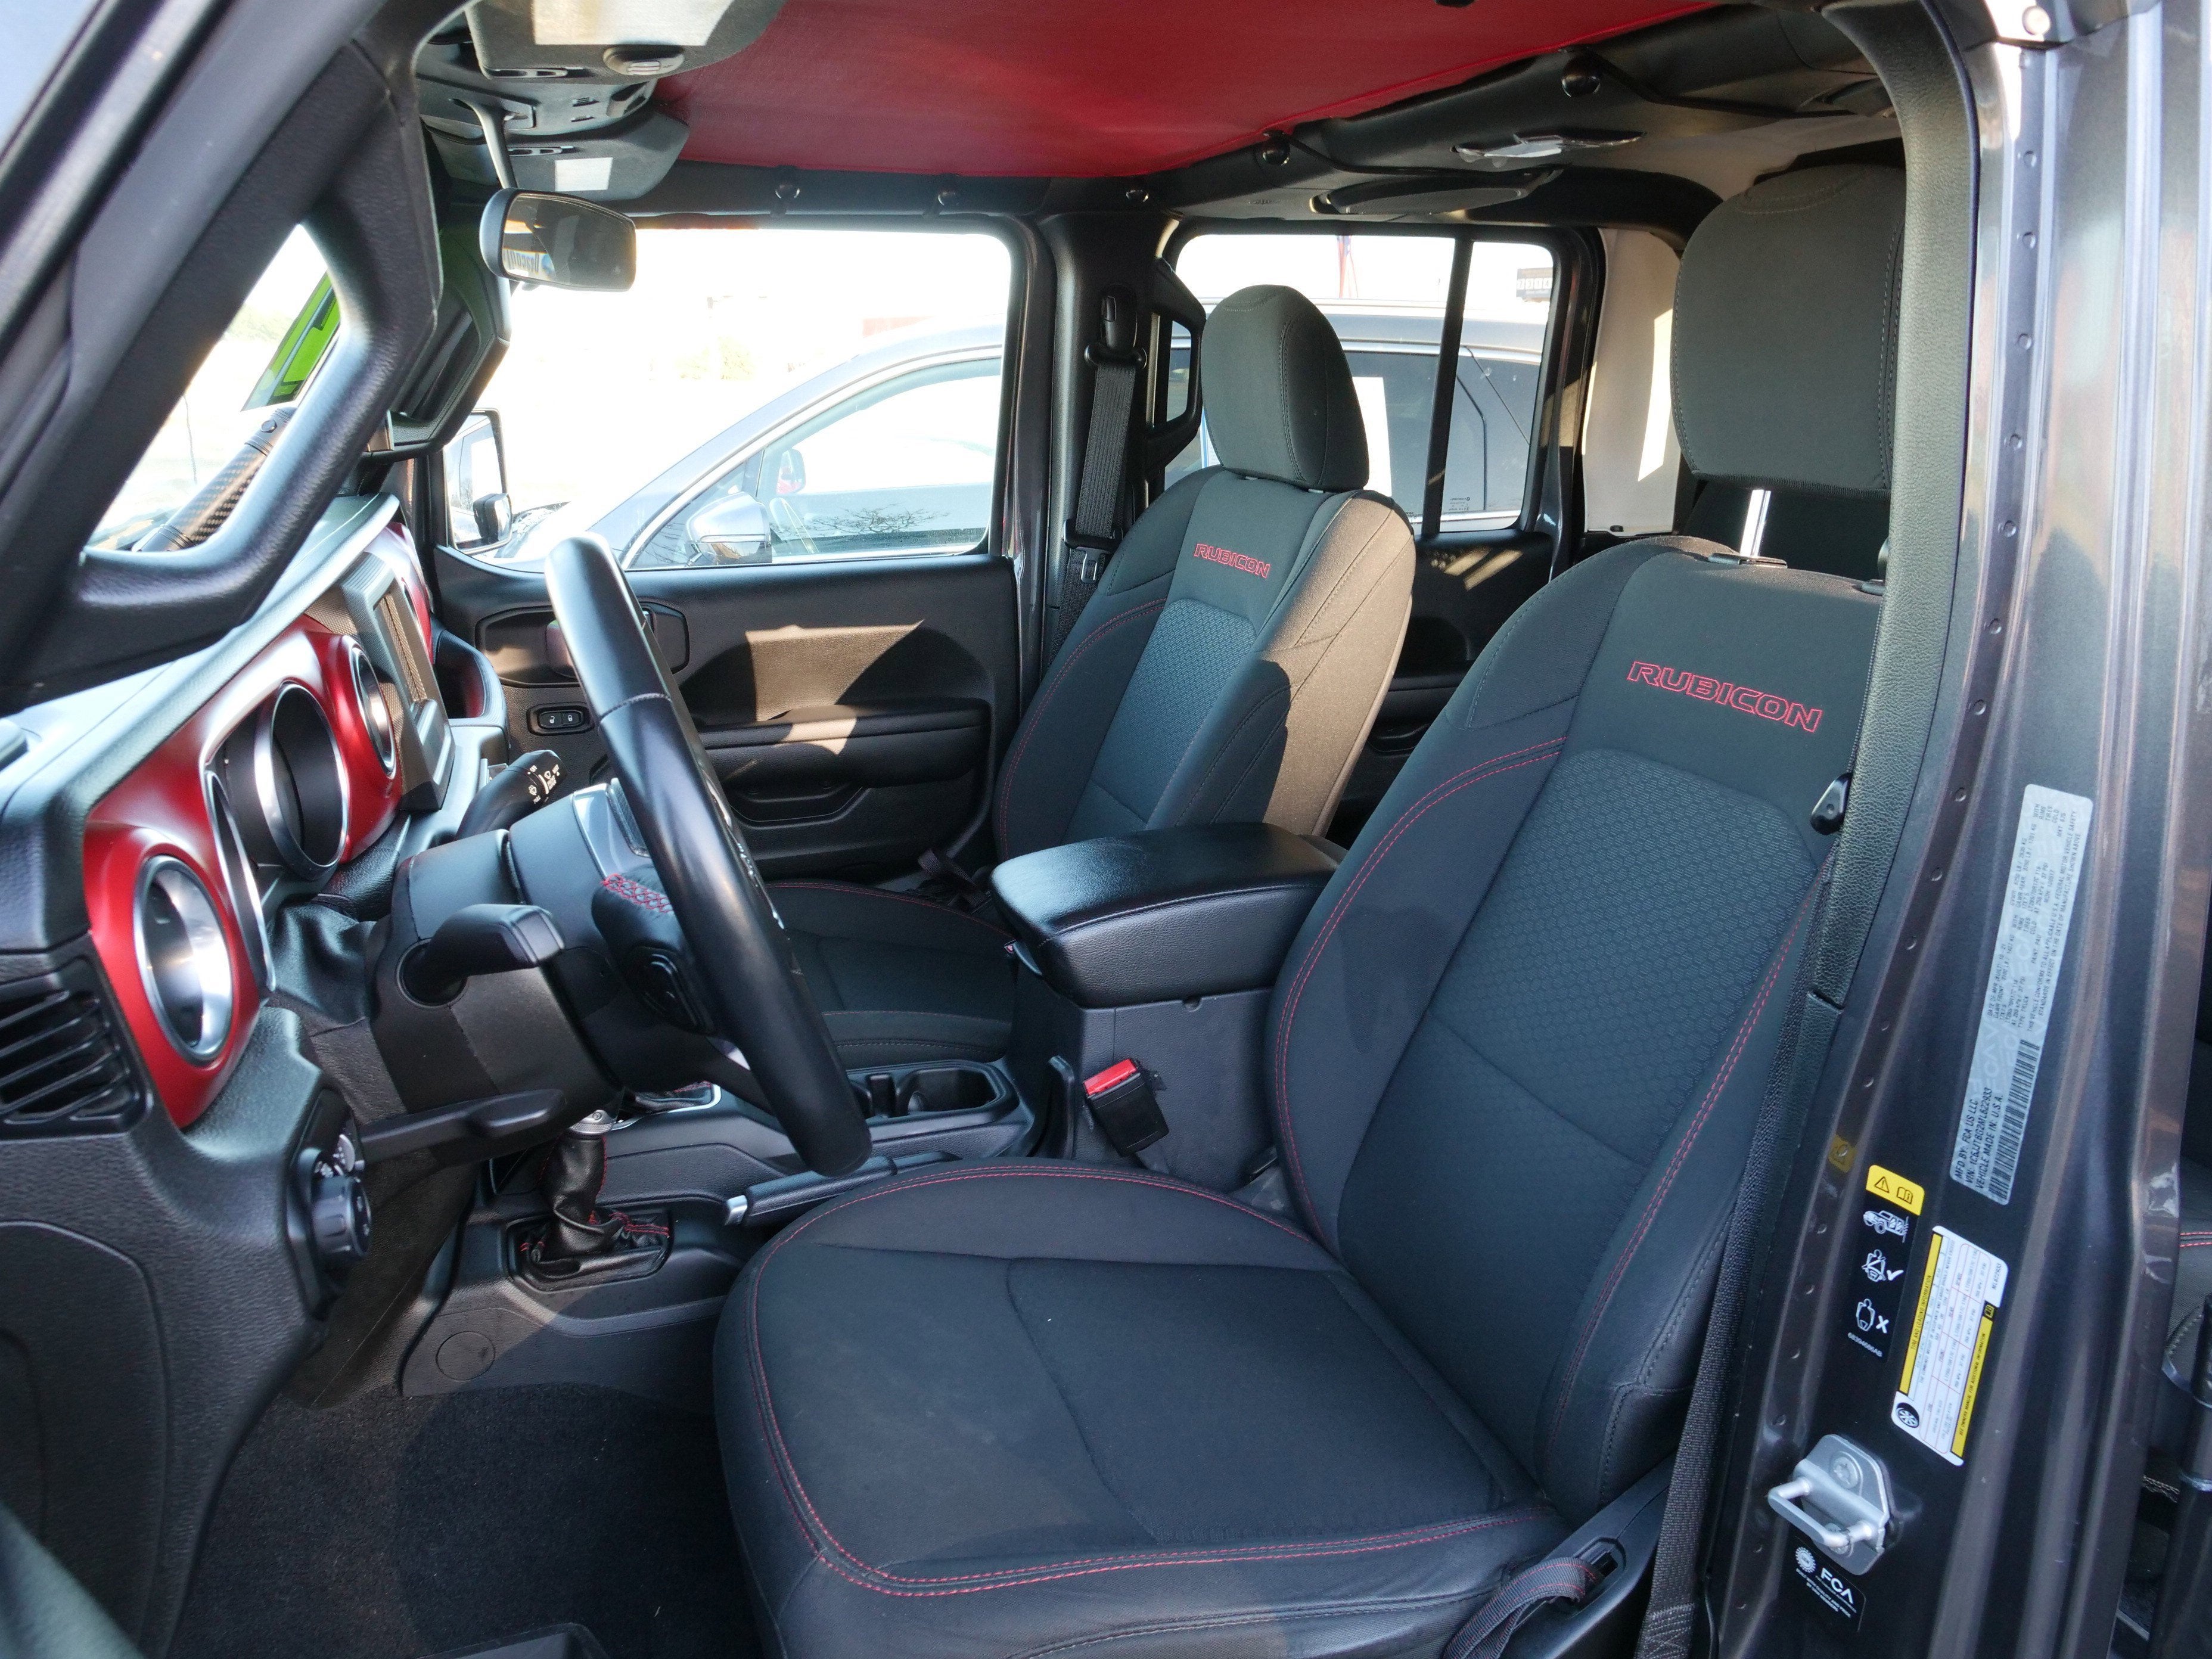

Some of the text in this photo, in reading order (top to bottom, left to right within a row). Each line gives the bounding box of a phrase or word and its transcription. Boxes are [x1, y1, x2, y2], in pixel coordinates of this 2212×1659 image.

[1194, 542, 1271, 579] RUBICON
[1626, 660, 1824, 734] RUBICON
[2067, 810, 2078, 831] SAFETY
[2062, 832, 2073, 855] VEHICLE
[2059, 855, 2068, 874] MOTOR
[2067, 851, 2077, 872] SHOWN
[2053, 875, 2064, 900] FEDERAL
[2059, 872, 2073, 912] MANUFACTURE
[2043, 918, 2056, 950] APPLICABLE
[2054, 921, 2062, 936] DATE
[2039, 960, 2047, 969] TO
[2050, 948, 2057, 957] ON
[2046, 958, 2055, 977] EFFECT
[2033, 969, 2045, 998] CONFORMS
[2029, 998, 2039, 1020] VEHICLE
[2038, 984, 2050, 1017] STANDARDS
[1954, 1097, 1978, 1179] MFD BY: FCA US LLC
[1975, 1091, 2003, 1191] VEHICLE MADE IN: U.S.A.
[1964, 1166, 1976, 1185] VIN:
[1820, 1567, 1854, 1604] FCA
